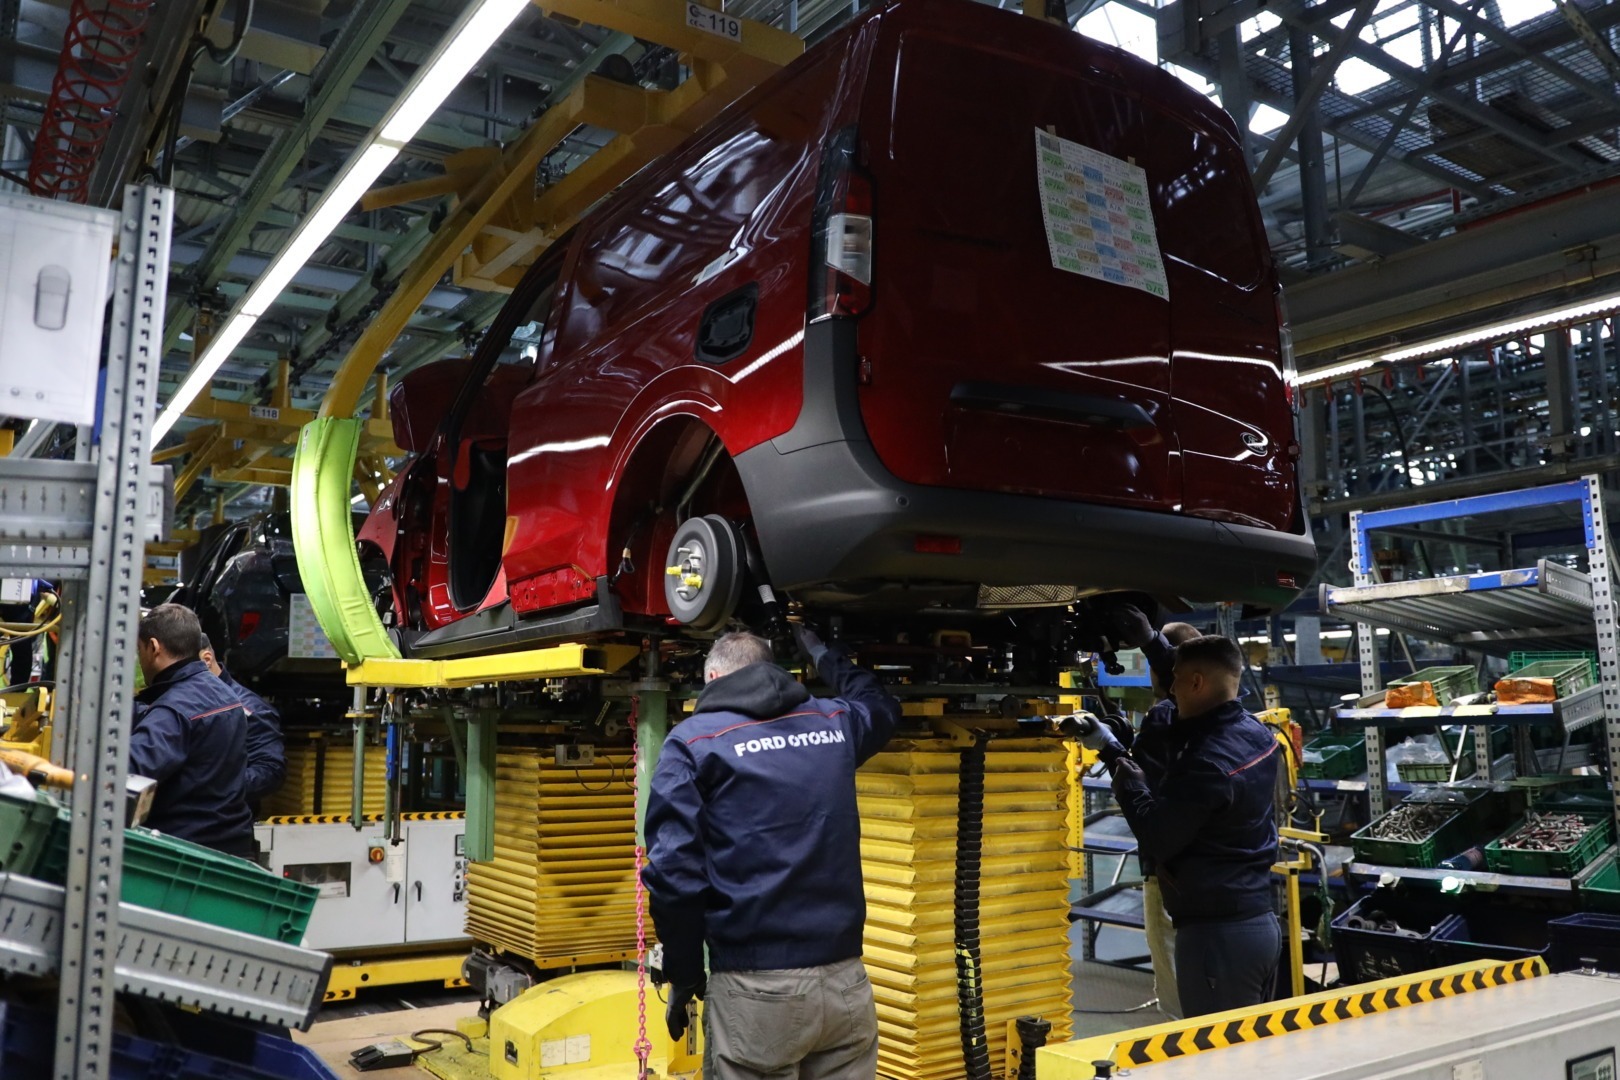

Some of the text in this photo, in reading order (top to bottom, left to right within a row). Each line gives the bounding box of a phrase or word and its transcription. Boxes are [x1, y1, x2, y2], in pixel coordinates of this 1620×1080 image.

[709, 14, 739, 37] 119
[262, 408, 278, 418] 118
[734, 730, 846, 757] FORD OTOSAN
